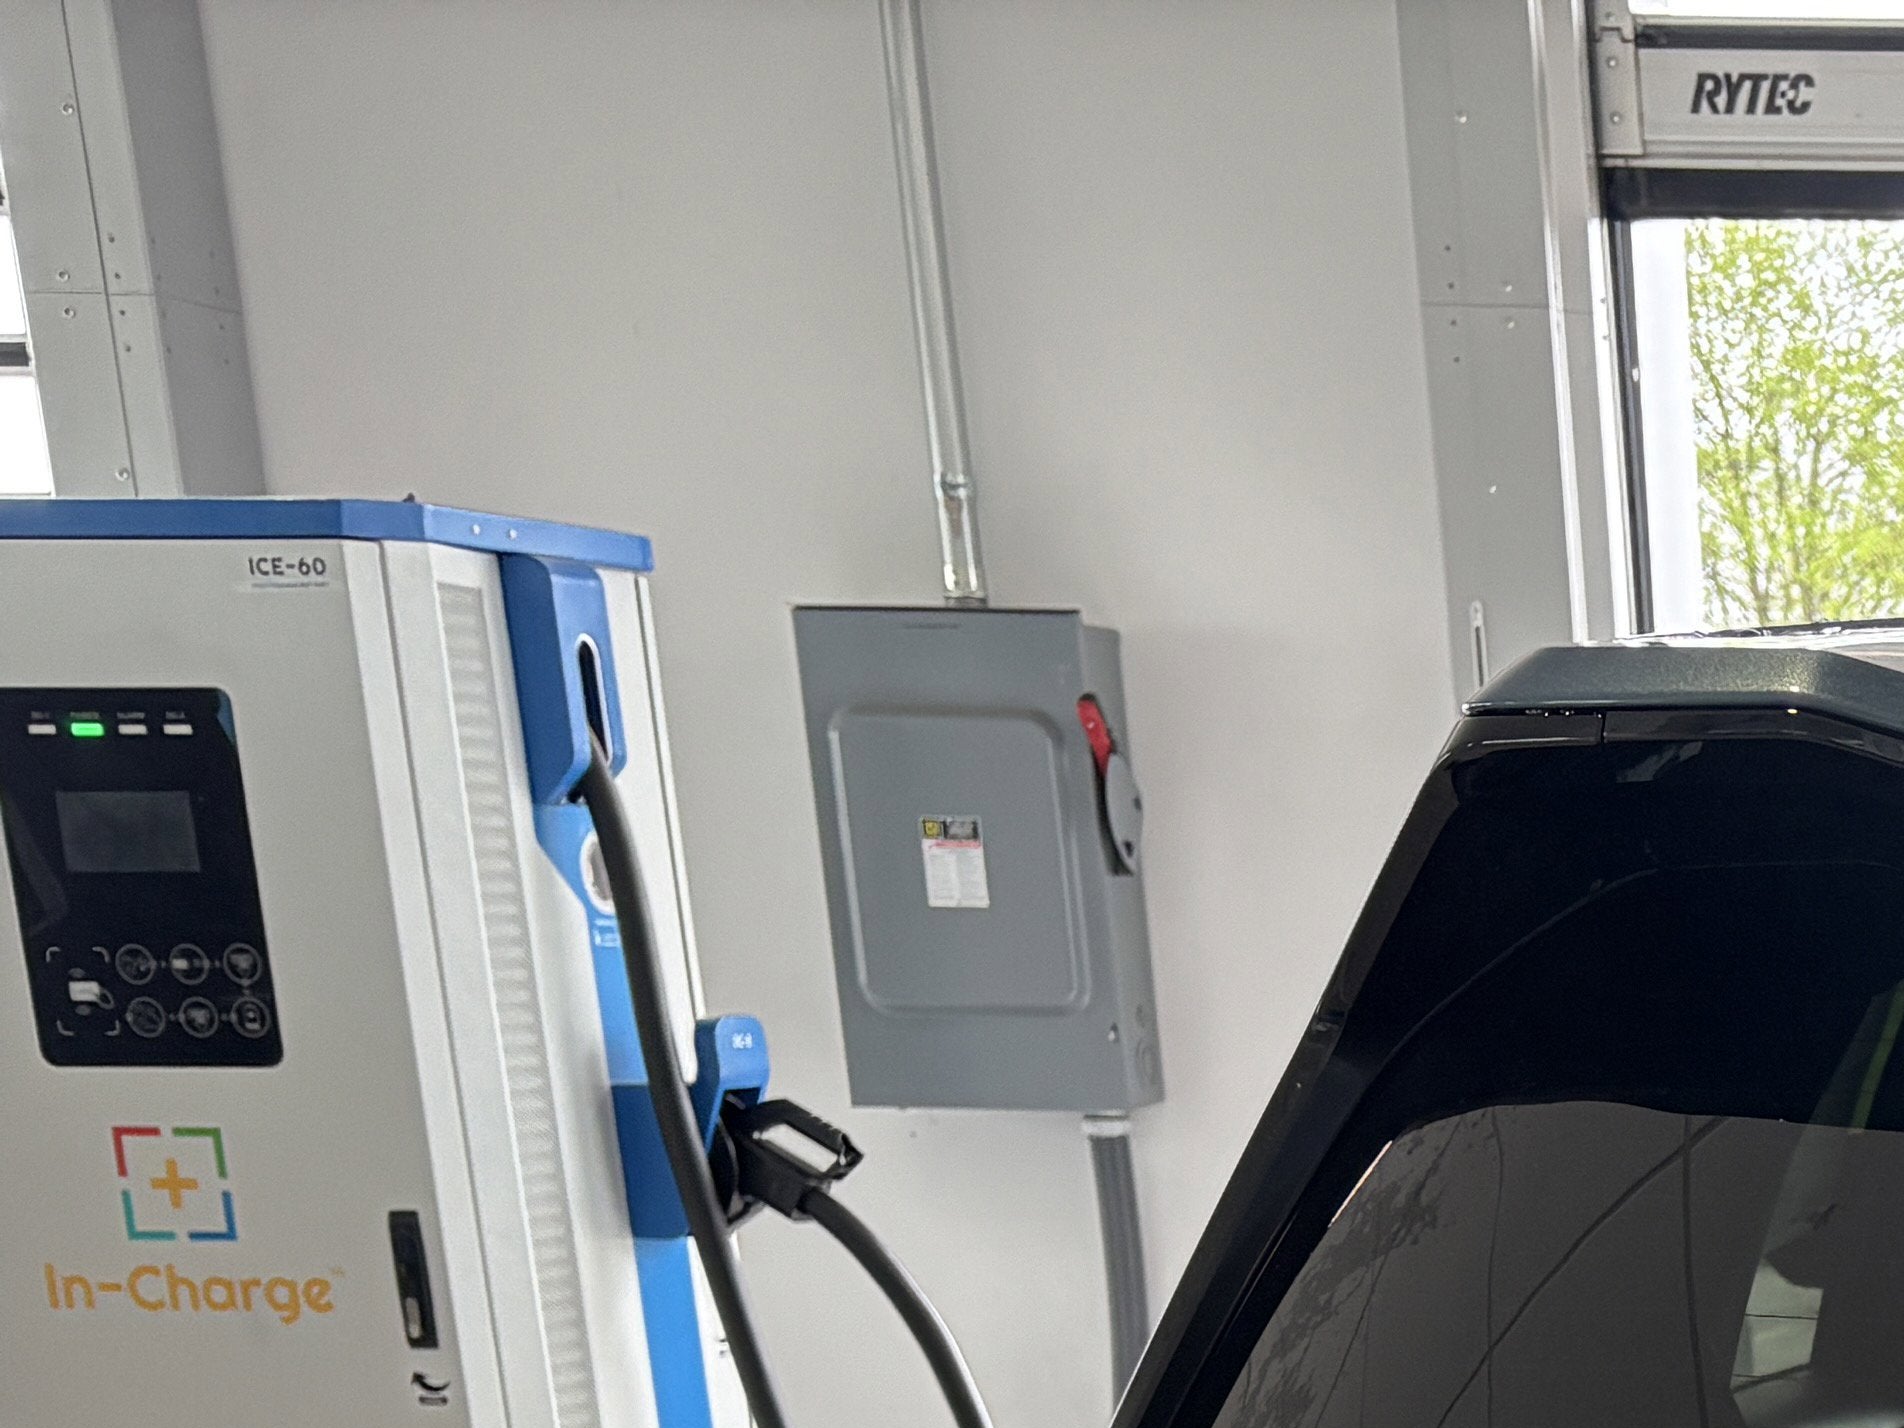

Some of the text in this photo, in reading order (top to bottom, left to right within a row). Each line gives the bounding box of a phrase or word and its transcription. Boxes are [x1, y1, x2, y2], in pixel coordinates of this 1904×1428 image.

[1690, 72, 1816, 116] RYTEC
[248, 556, 327, 576] ICE-60
[44, 1262, 335, 1326] In-Charge
